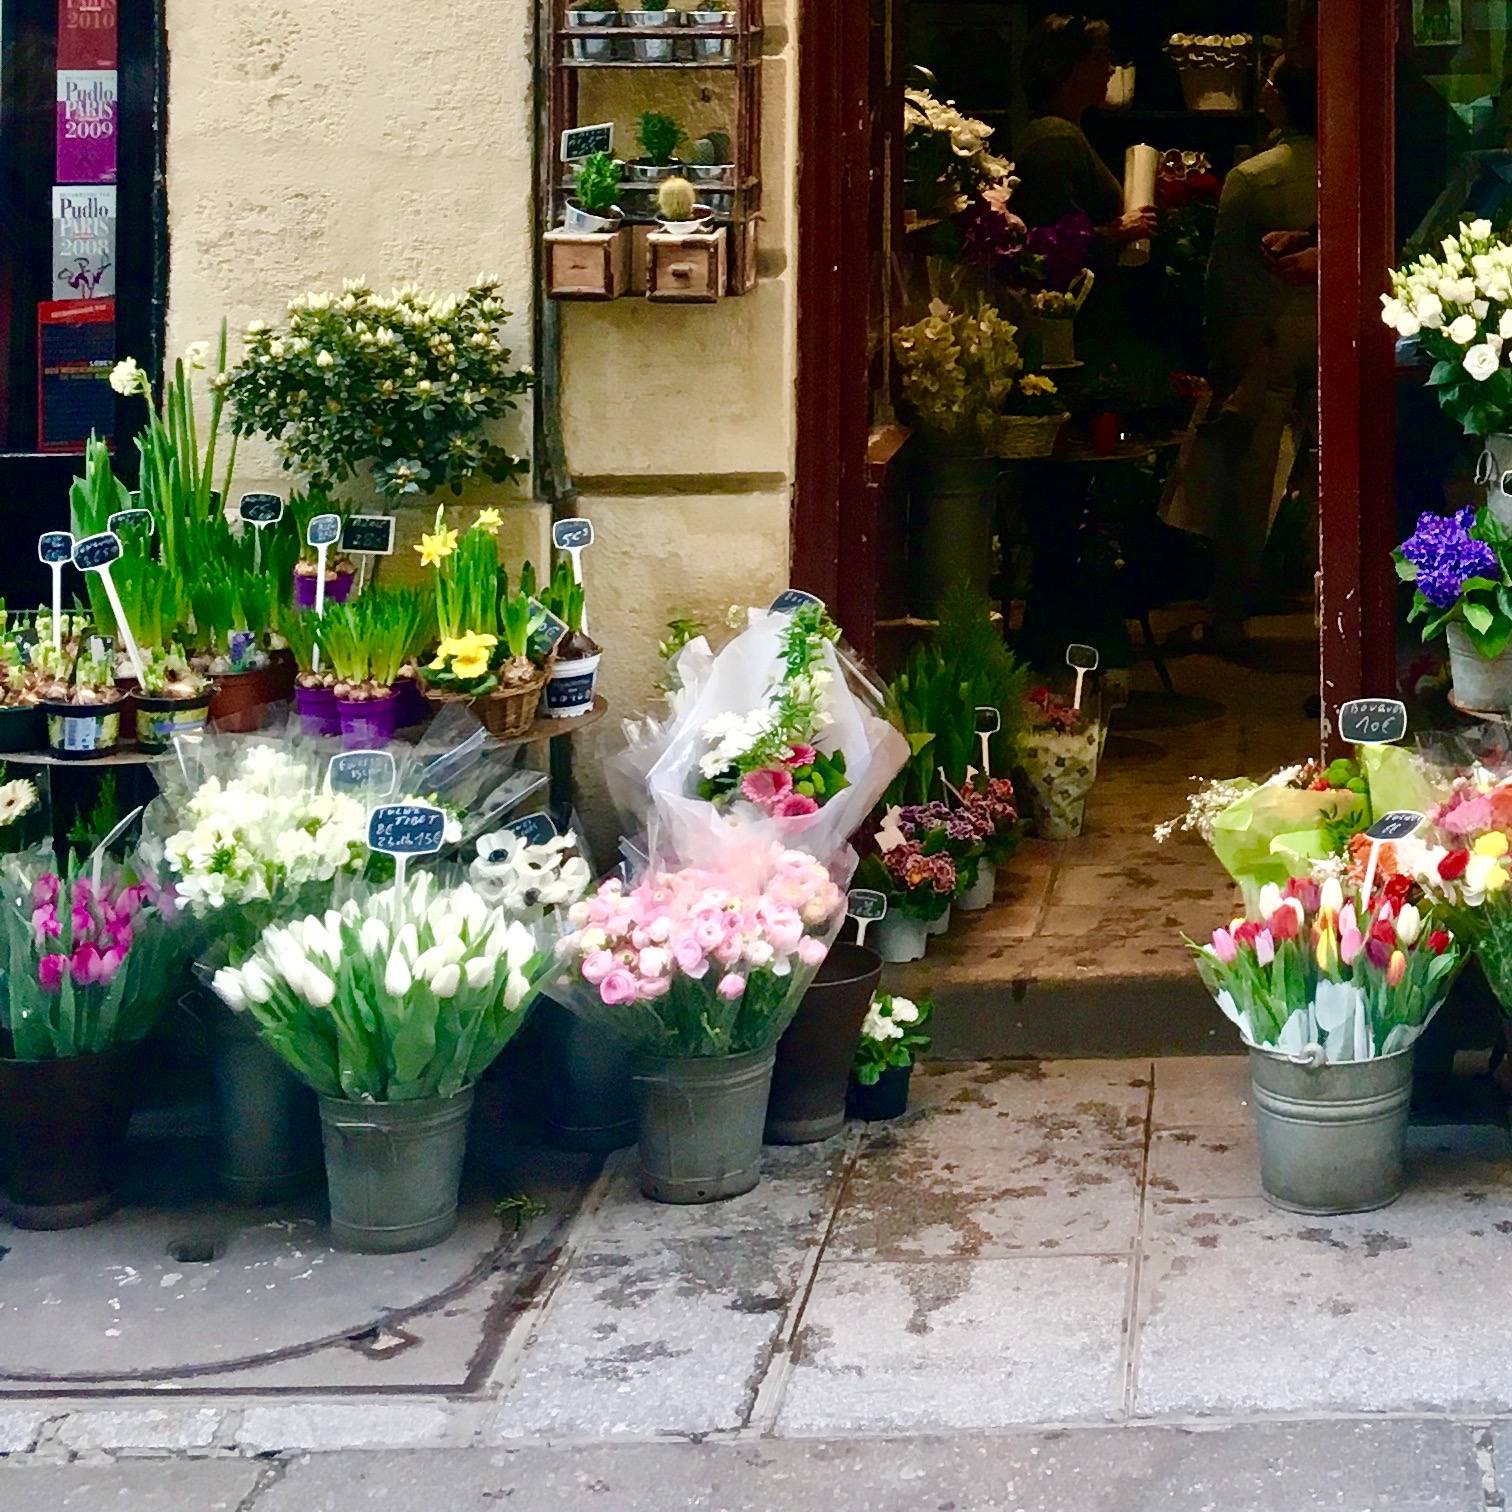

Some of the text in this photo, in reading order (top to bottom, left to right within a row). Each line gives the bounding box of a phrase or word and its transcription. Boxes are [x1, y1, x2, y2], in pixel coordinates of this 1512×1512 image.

[67, 12, 115, 29] 2010
[65, 81, 114, 102] Pudlo
[65, 99, 113, 120] PARIS
[64, 120, 114, 139] 2009
[59, 197, 109, 219] Pudlo
[60, 217, 110, 237] PARIS
[60, 238, 110, 256] 2008
[1355, 715, 1397, 734] 10€
